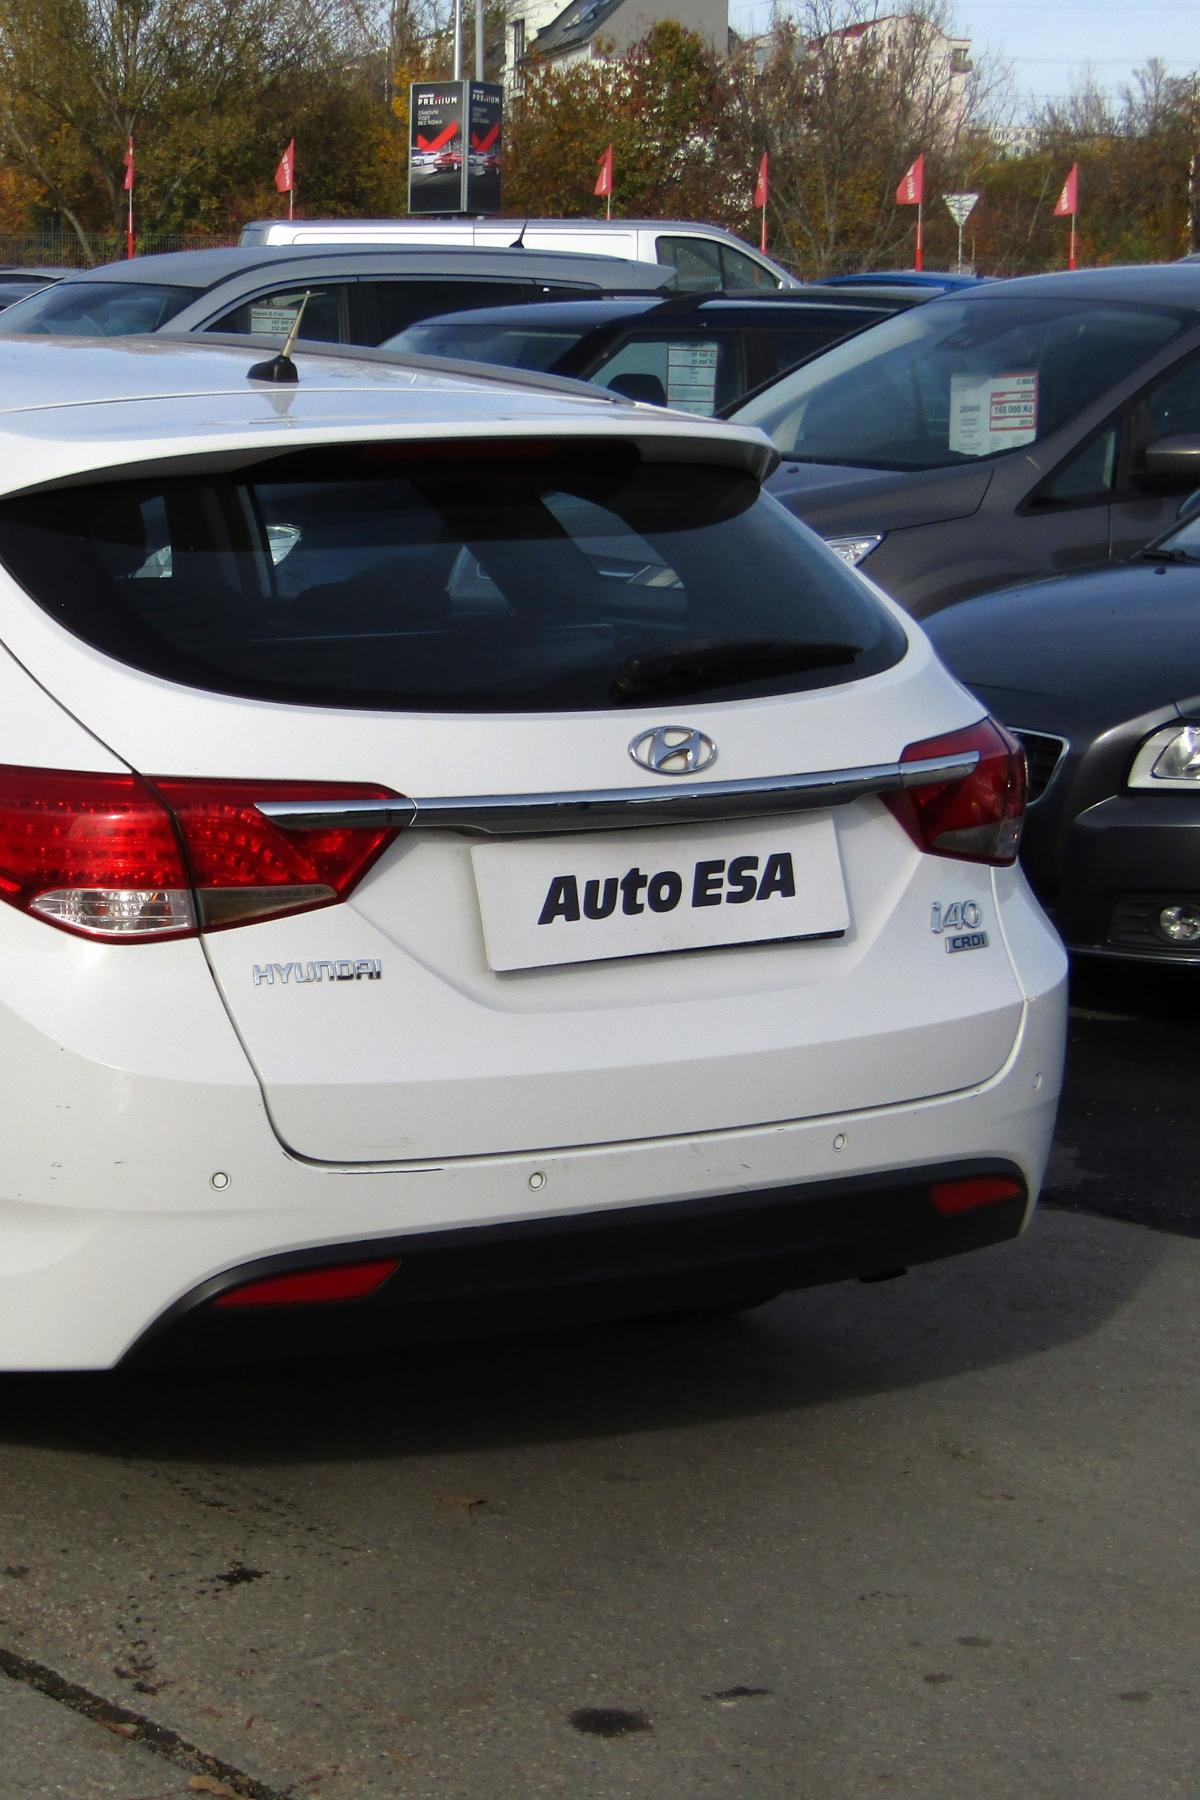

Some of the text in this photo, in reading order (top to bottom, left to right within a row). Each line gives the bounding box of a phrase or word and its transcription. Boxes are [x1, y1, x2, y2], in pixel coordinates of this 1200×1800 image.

[537, 852, 797, 926] Auto ESA
[930, 899, 983, 934] i40
[952, 934, 985, 949] CRDi
[252, 959, 382, 986] HYUNDAI
